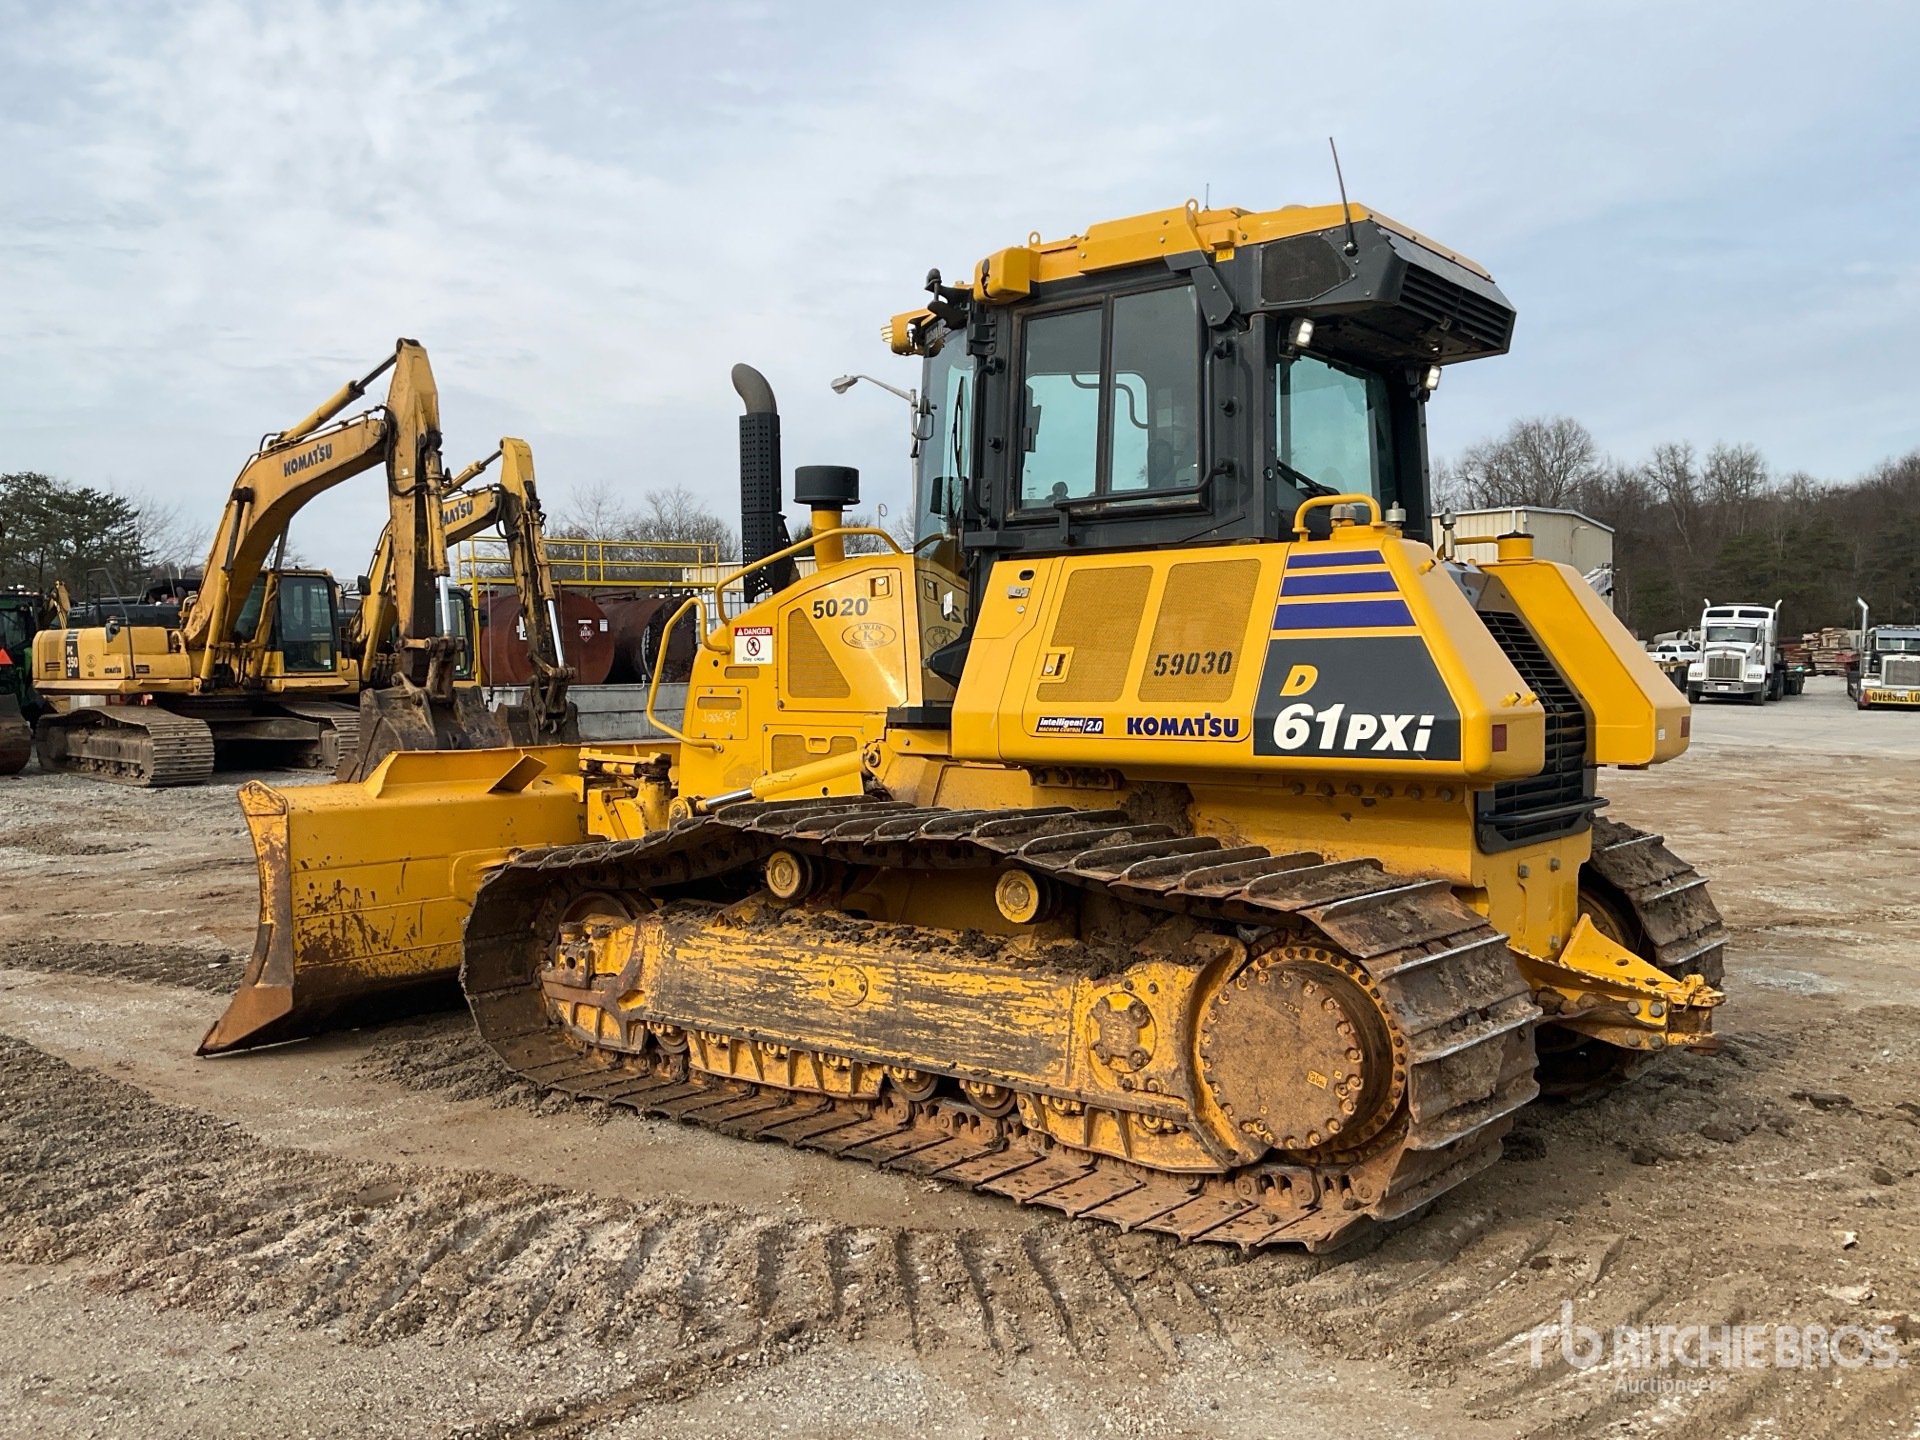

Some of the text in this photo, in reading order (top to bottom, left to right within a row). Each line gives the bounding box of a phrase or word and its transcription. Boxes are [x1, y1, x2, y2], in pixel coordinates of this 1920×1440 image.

[283, 443, 332, 477] KOMATSU
[443, 500, 473, 525] MATSU
[812, 597, 869, 619] 5020
[863, 631, 874, 641] K
[1154, 650, 1233, 677] 59030
[1279, 664, 1319, 697] D
[1085, 720, 1103, 732] 2.0
[1127, 712, 1239, 738] KOMATSU
[1273, 702, 1435, 752] 61PXi
